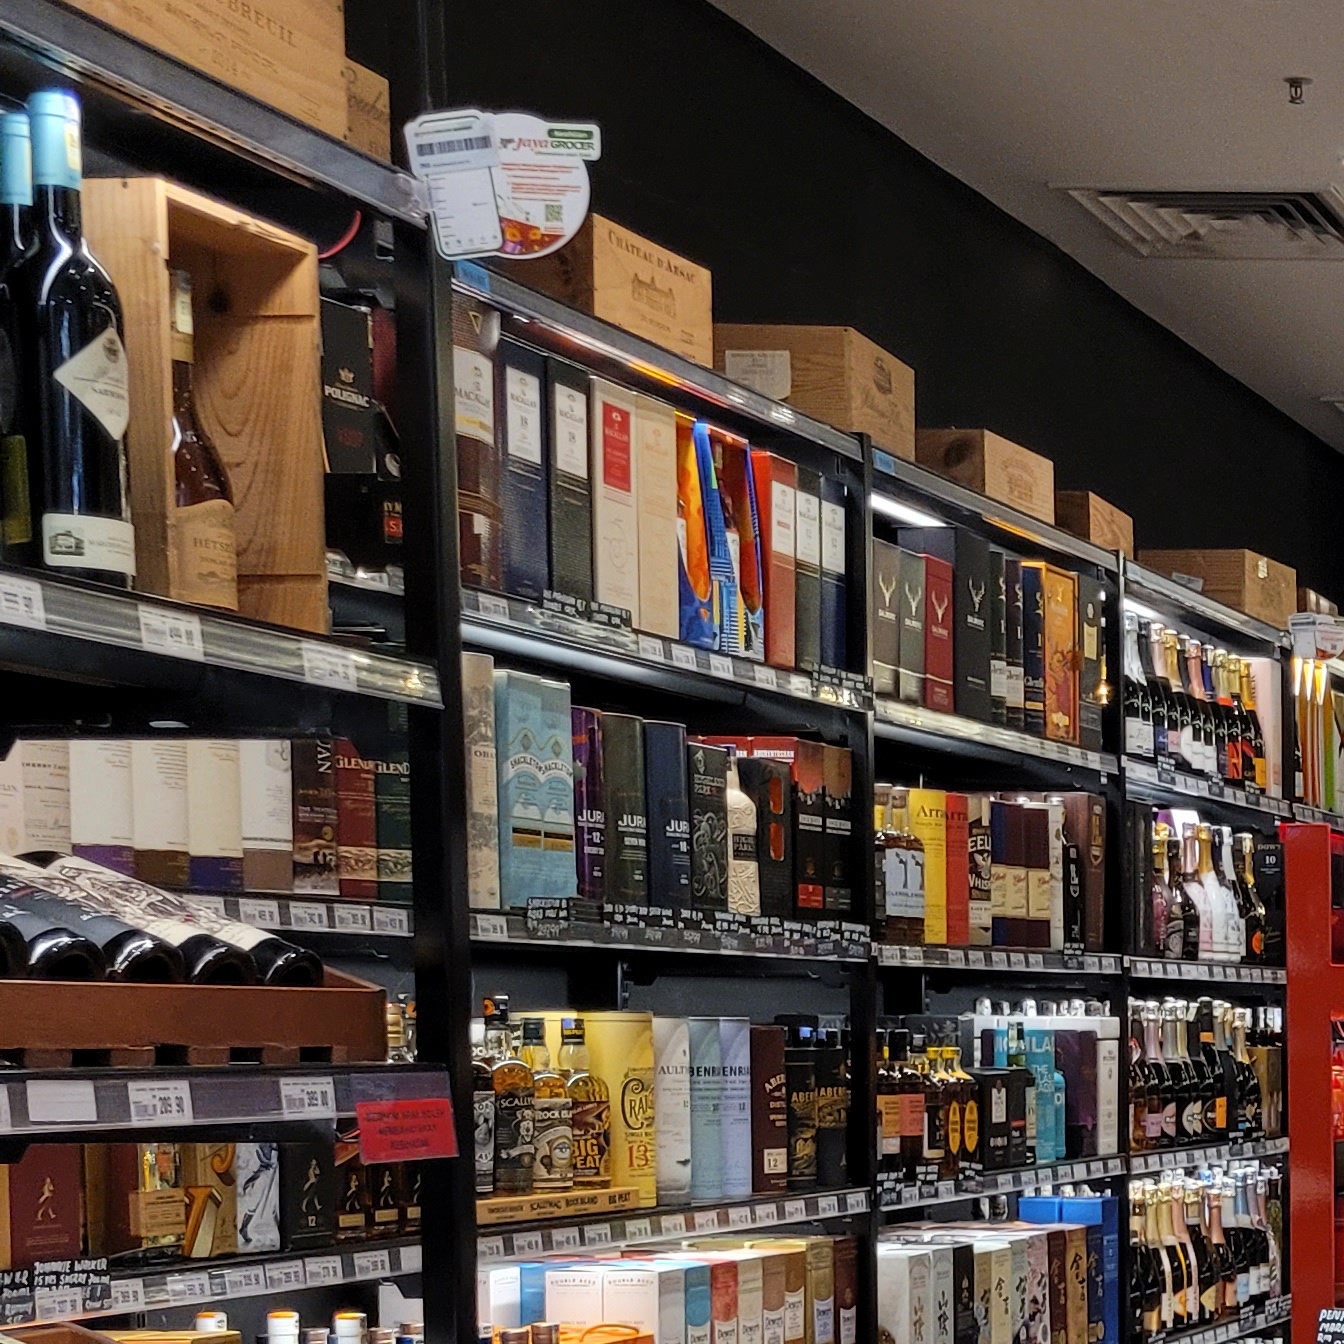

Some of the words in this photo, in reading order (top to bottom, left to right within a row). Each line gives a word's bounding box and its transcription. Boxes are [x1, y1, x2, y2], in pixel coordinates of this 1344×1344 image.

[551, 142, 595, 150] GROCER
[572, 1138, 598, 1156] BIG
[628, 1145, 649, 1168] 13
[767, 1158, 778, 1168] 12
